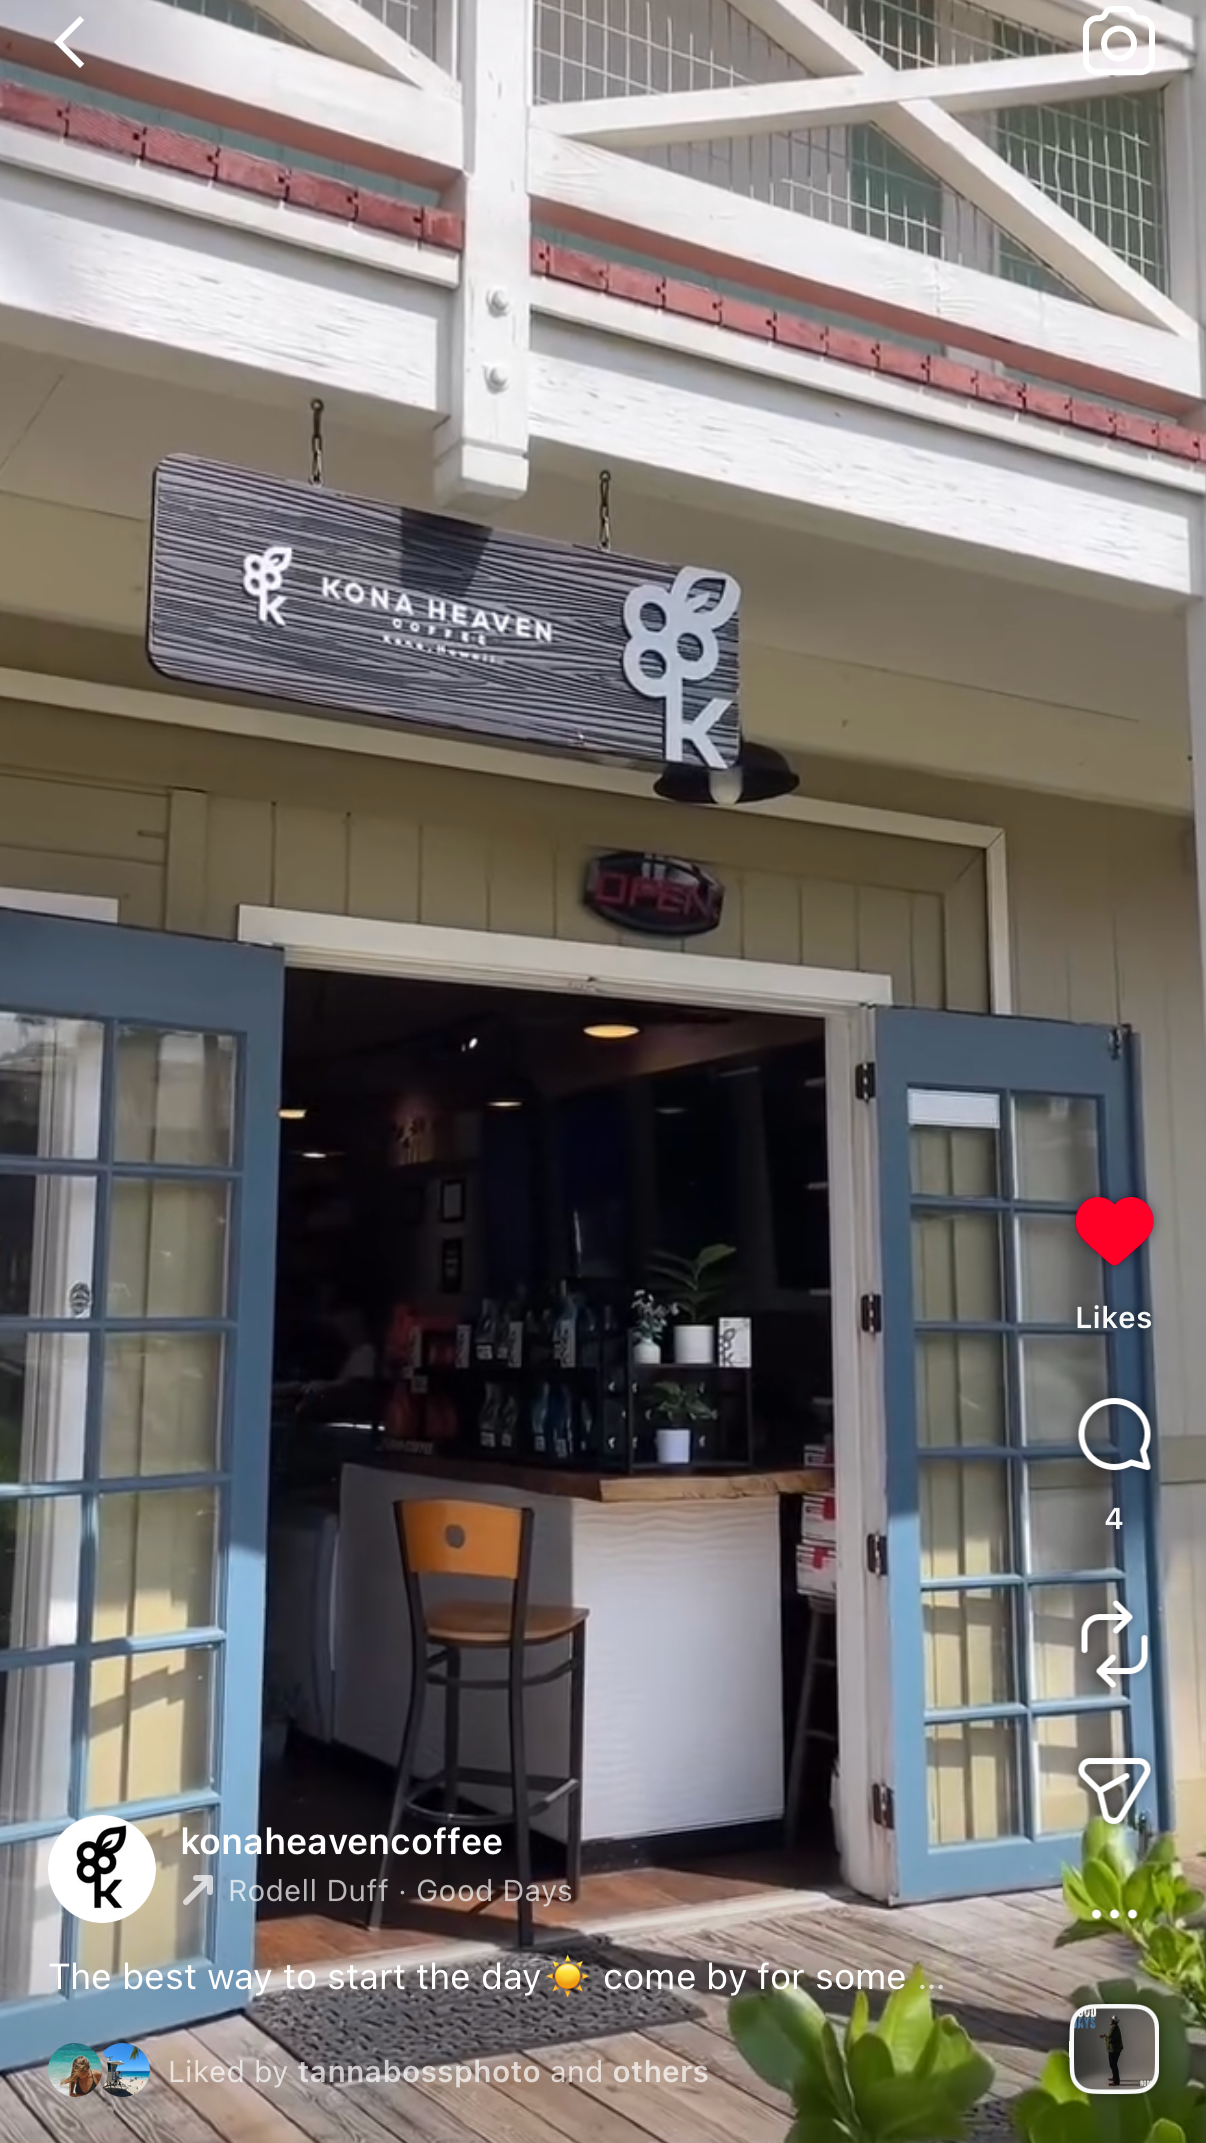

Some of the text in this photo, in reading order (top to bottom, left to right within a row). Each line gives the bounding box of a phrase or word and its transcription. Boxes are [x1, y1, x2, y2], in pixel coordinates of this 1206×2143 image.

[321, 576, 553, 643] KONA HEAVEN
[391, 617, 488, 647] COFFEE
[595, 872, 714, 919] OPEN
